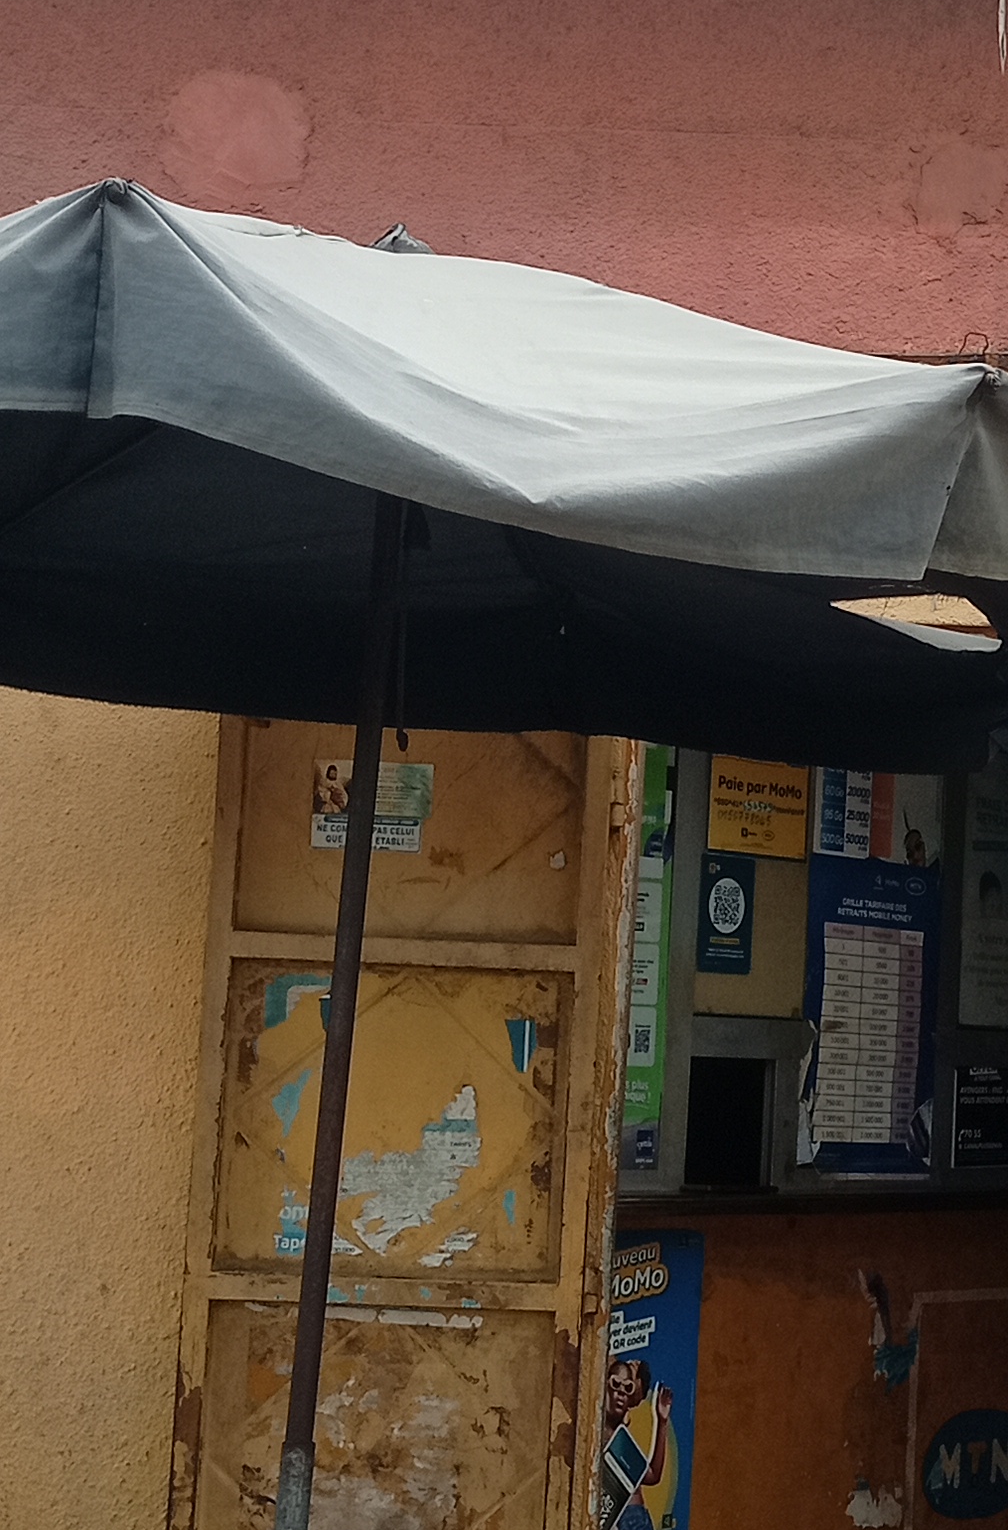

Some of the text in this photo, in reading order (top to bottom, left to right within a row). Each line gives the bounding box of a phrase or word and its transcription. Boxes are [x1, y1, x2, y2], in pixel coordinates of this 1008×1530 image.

[718, 775, 802, 800] Paie par MoMo
[390, 827, 414, 836] CELUI
[612, 1247, 656, 1270] uveau
[622, 1319, 653, 1335] devient
[612, 1334, 647, 1350] QR code
